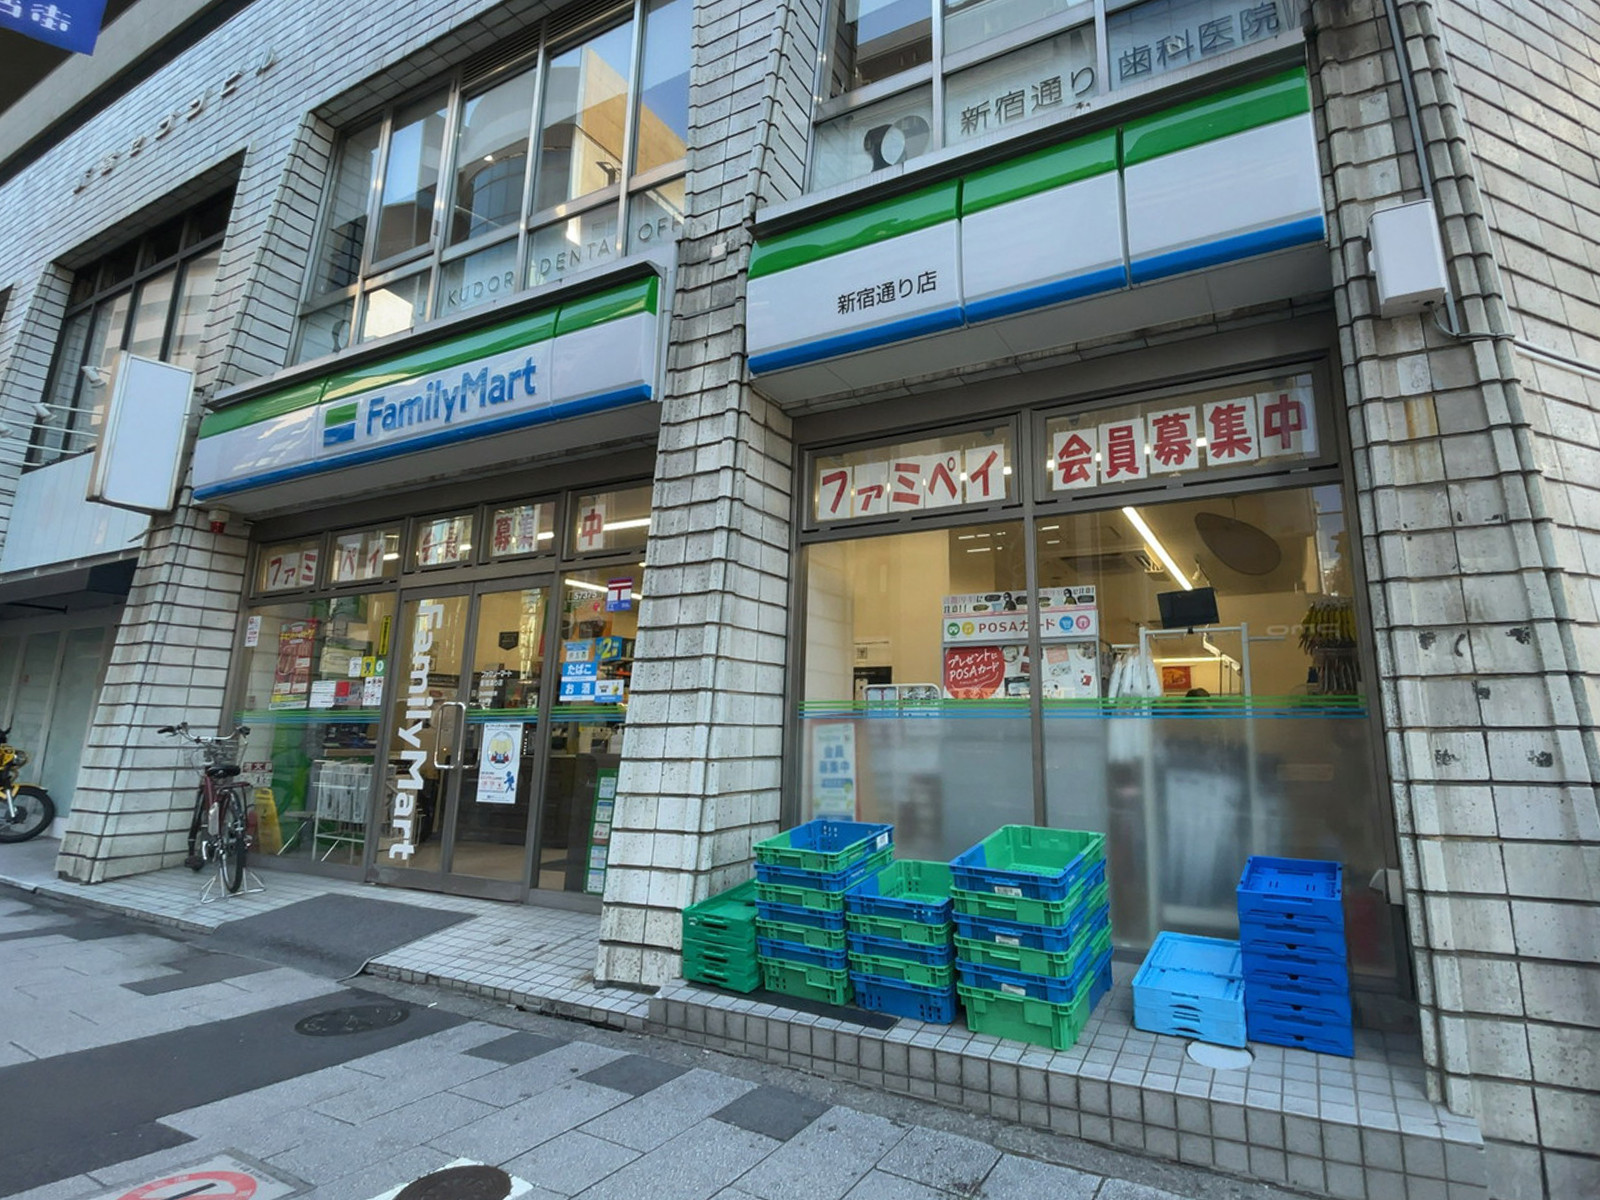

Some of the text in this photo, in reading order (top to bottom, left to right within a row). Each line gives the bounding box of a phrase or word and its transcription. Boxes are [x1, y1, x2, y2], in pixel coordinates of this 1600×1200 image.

[960, 1, 1281, 136] 新宿通り 歯科医院
[448, 270, 515, 306] KUDOR
[539, 238, 611, 277] DENTA
[837, 270, 938, 315] 新宿通り店
[366, 356, 537, 436] FamilyMart
[1058, 393, 1308, 482] 会員募集中
[820, 448, 999, 514] ファミペイ
[270, 554, 317, 586] ファミ
[582, 508, 602, 546] 中
[567, 664, 592, 676] たばこ
[948, 648, 999, 668] プレゼントに
[949, 661, 1000, 681] POSAカード
[389, 599, 445, 860] FamilyMart
